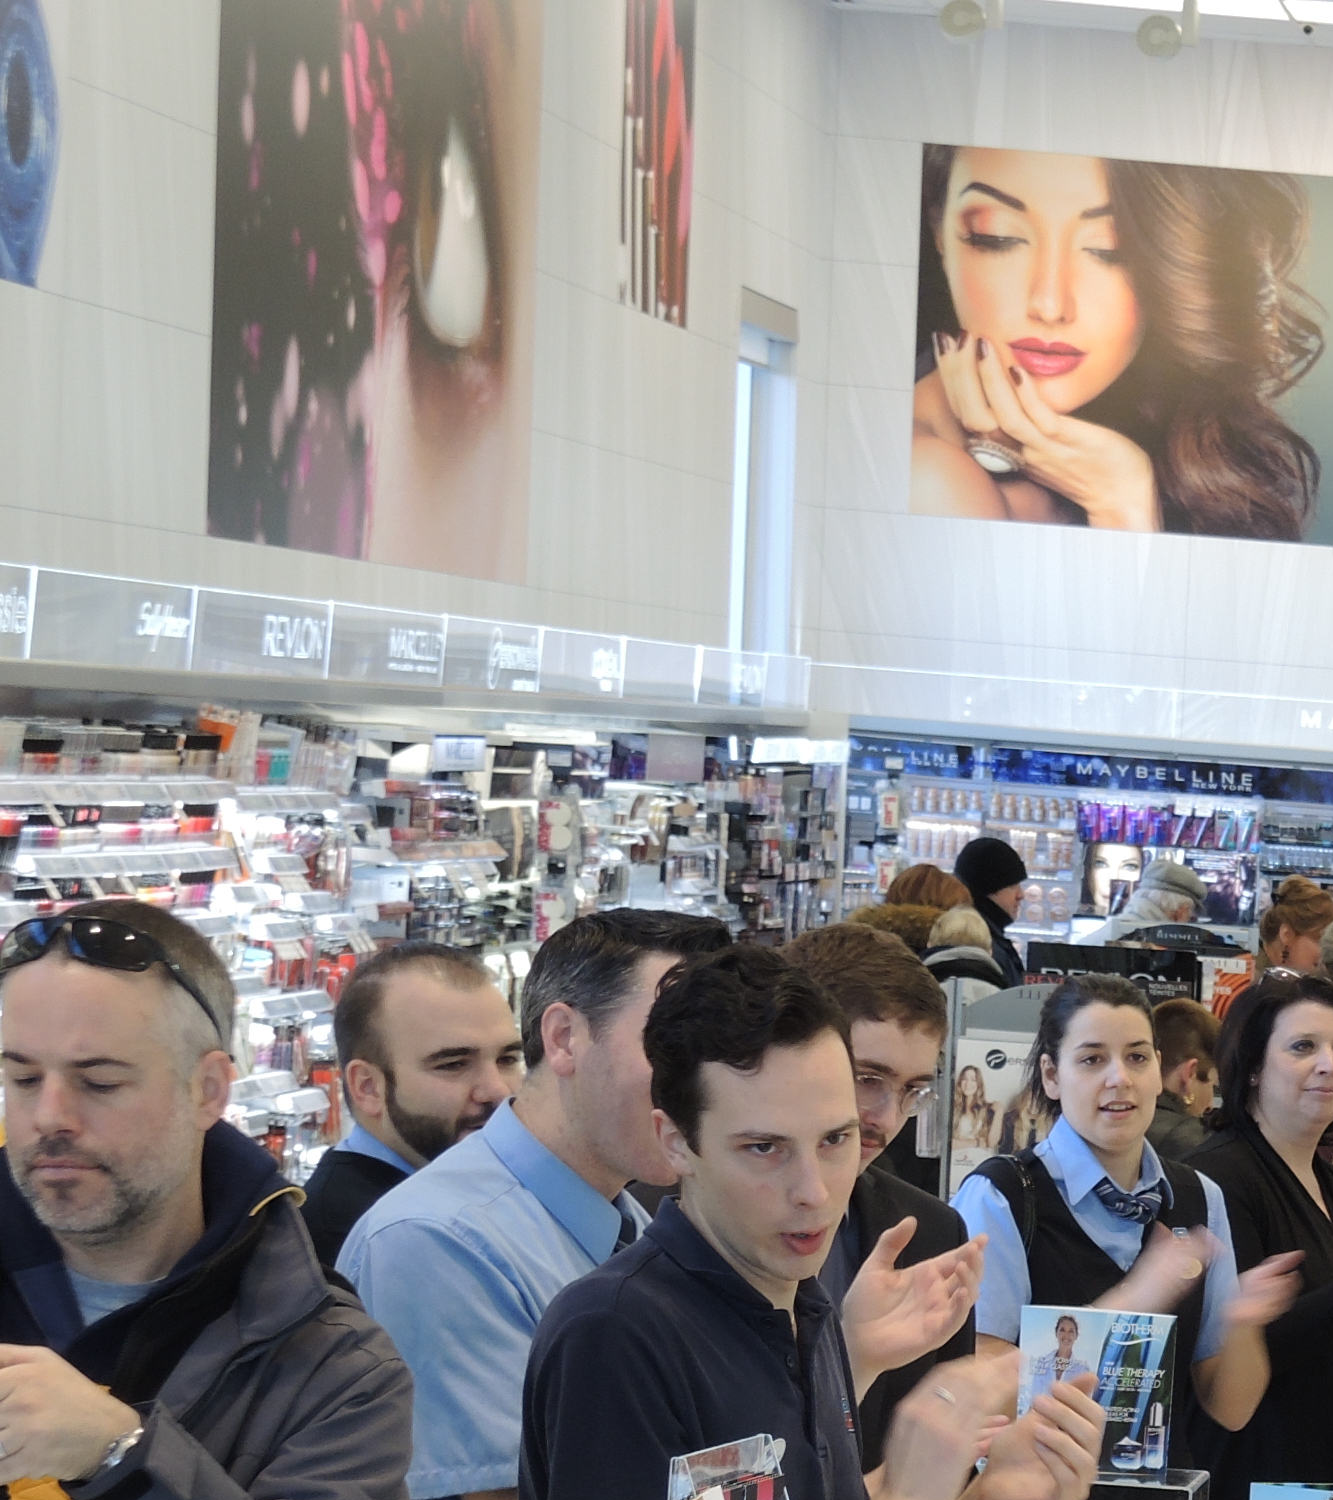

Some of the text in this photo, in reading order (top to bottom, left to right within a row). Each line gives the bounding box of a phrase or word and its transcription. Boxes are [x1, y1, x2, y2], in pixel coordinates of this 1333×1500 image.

[261, 614, 326, 660] REVLON
[1077, 761, 1253, 786] MAYBELLINE
[1191, 780, 1253, 792] NEW YORK
[1111, 1322, 1165, 1336] BIOTHERM
[1102, 1366, 1123, 1377] BLUE
[1126, 1368, 1165, 1379] THERAPY
[1100, 1377, 1161, 1389] ACCELERATED
